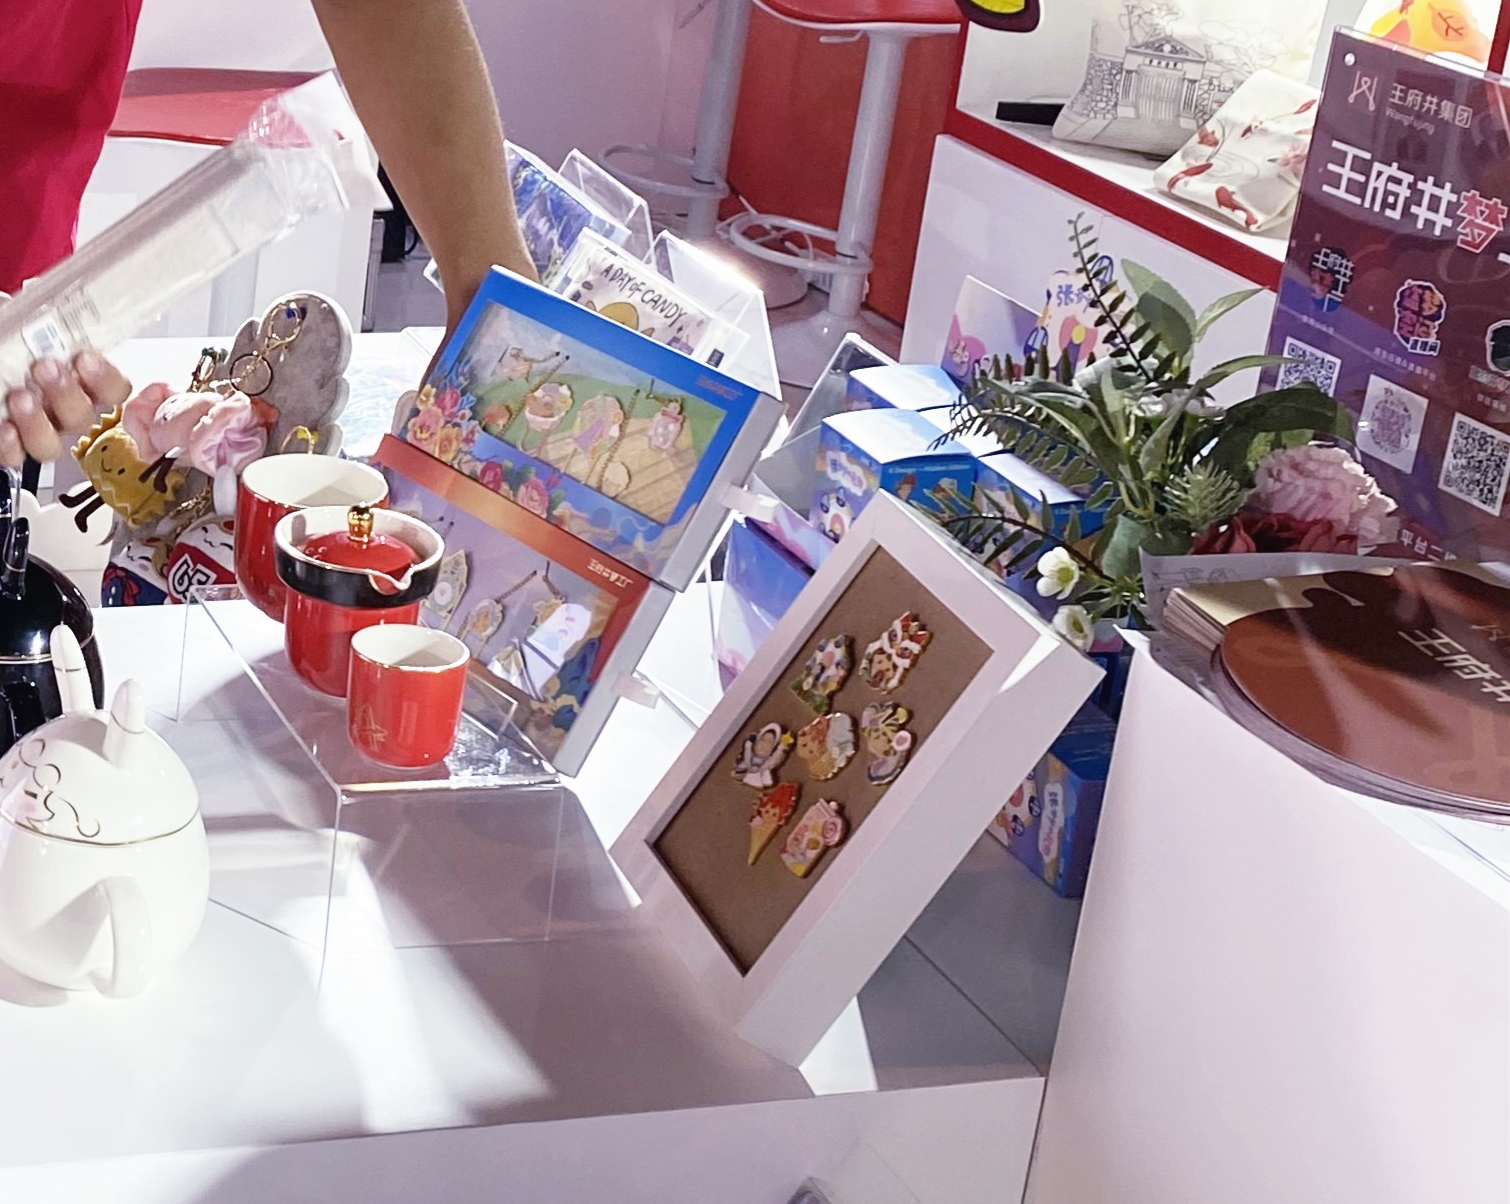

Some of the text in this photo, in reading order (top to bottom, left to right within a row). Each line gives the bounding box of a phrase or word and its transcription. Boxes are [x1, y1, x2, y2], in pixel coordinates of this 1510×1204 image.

[1388, 82, 1474, 129] 王府井集团
[1321, 139, 1510, 264] 王府井梦
[609, 267, 636, 293] DAY
[640, 288, 688, 328] CANDY
